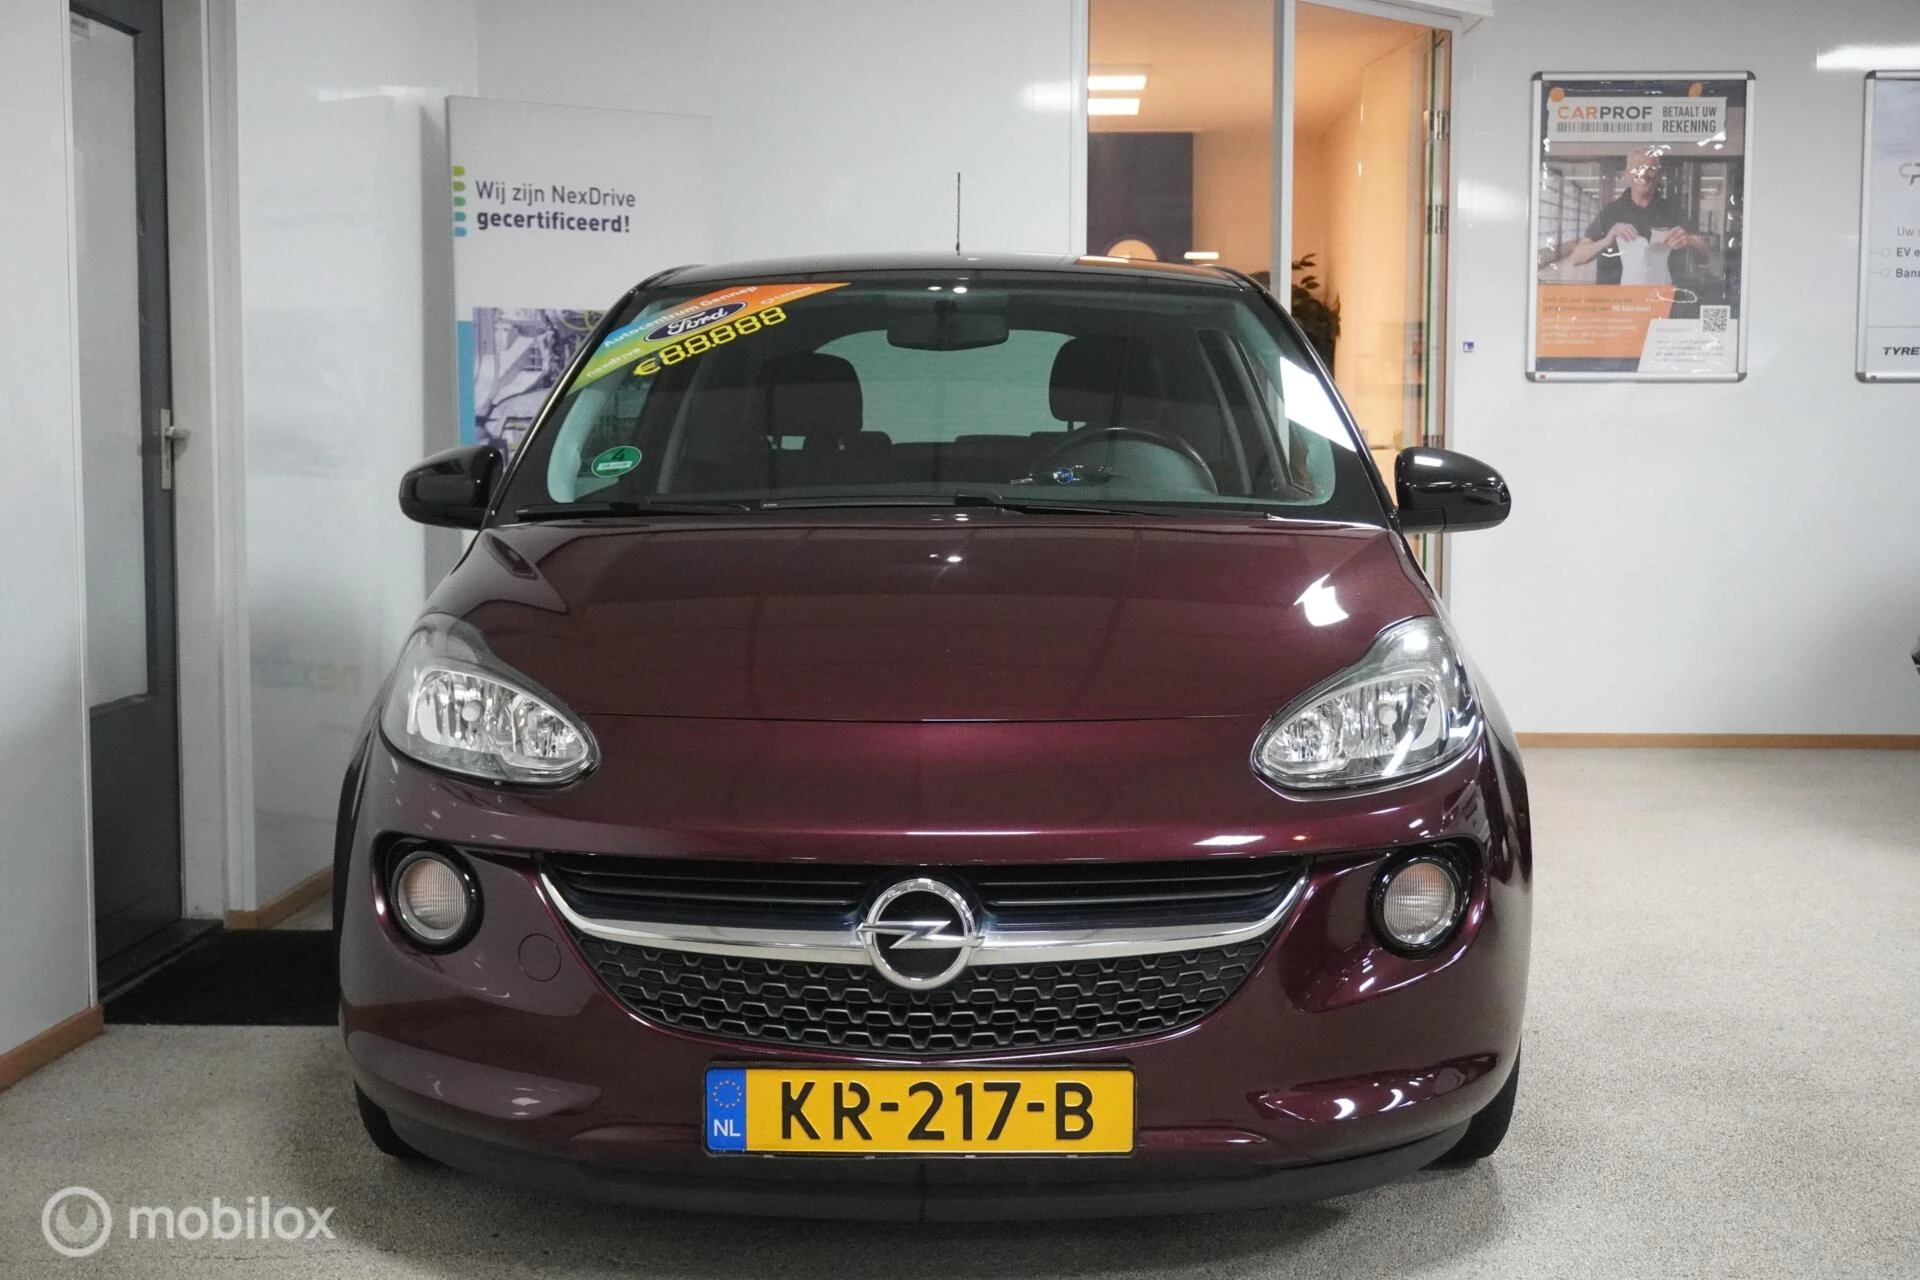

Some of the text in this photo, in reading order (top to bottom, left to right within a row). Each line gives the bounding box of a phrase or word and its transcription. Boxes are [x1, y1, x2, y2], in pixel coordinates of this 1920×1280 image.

[1557, 106, 1653, 119] CARPROF
[1662, 106, 1717, 118] BETAALT UW
[1662, 119, 1717, 133] REKENING
[475, 180, 636, 207] Wij zijn NexDrive
[477, 211, 630, 233] gecertificeerd!
[1896, 247, 1911, 257] EV
[604, 304, 699, 348] Autocentrum
[700, 286, 757, 306] Gennep
[666, 307, 729, 336] Ford
[781, 1081, 1094, 1141] KR-217-B
[713, 1119, 741, 1137] NL
